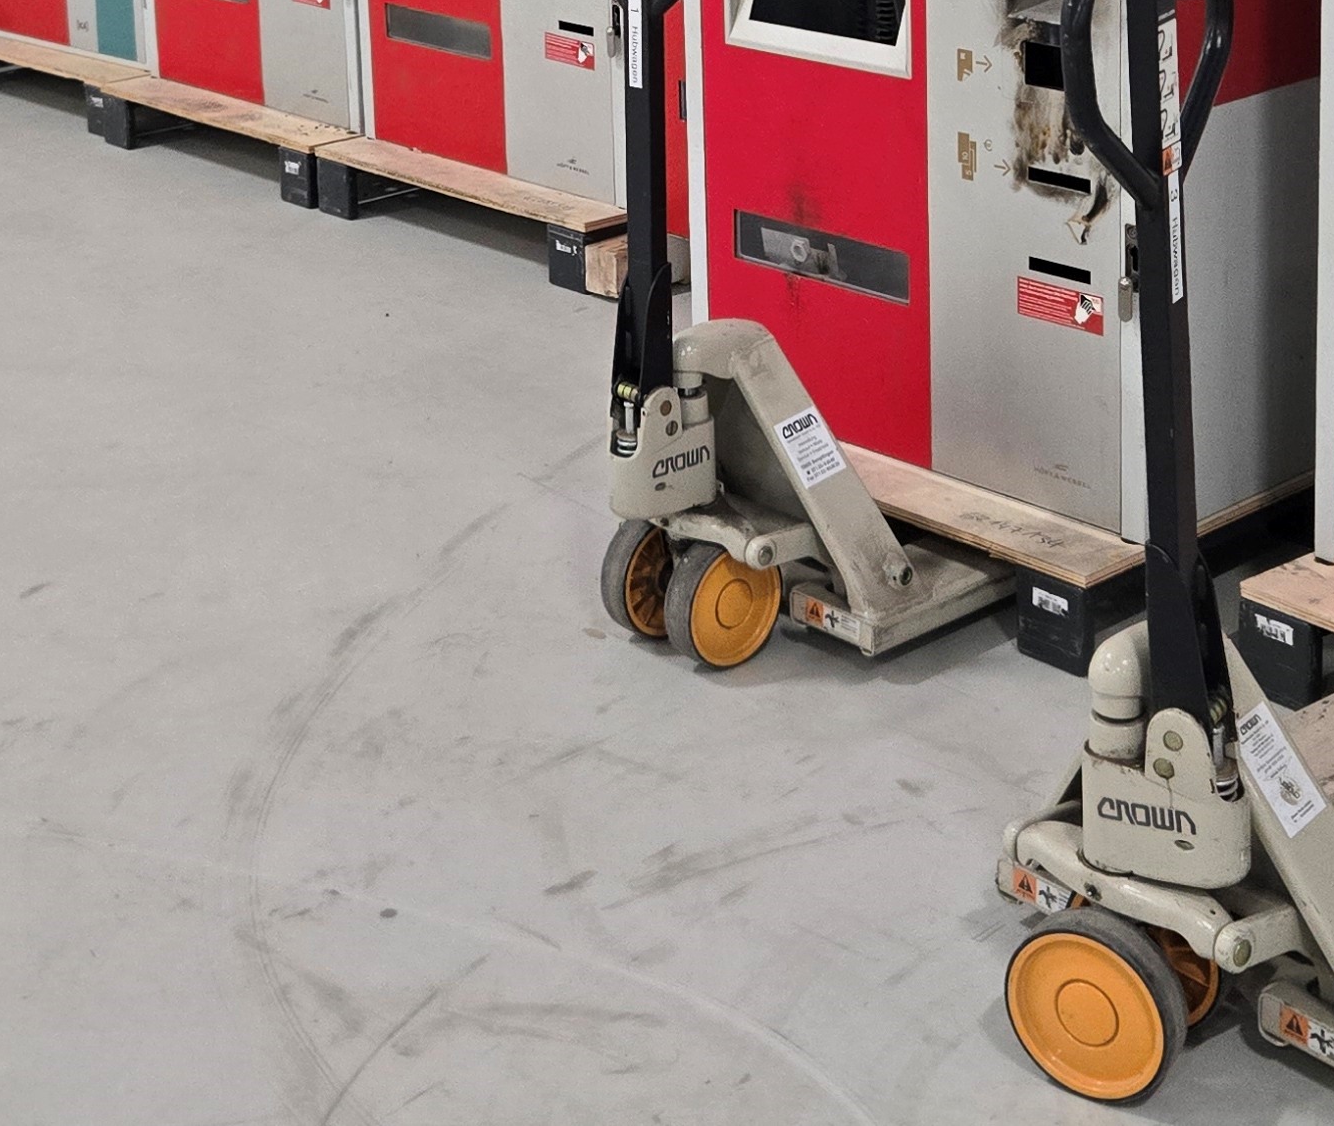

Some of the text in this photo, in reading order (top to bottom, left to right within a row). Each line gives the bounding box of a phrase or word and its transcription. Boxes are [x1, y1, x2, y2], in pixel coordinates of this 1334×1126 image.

[631, 25, 639, 84] Hubwagen
[1171, 216, 1182, 297] Hubwagen
[782, 413, 819, 440] CROWN
[652, 445, 710, 479] CROWN
[1096, 796, 1197, 836] CROWN
